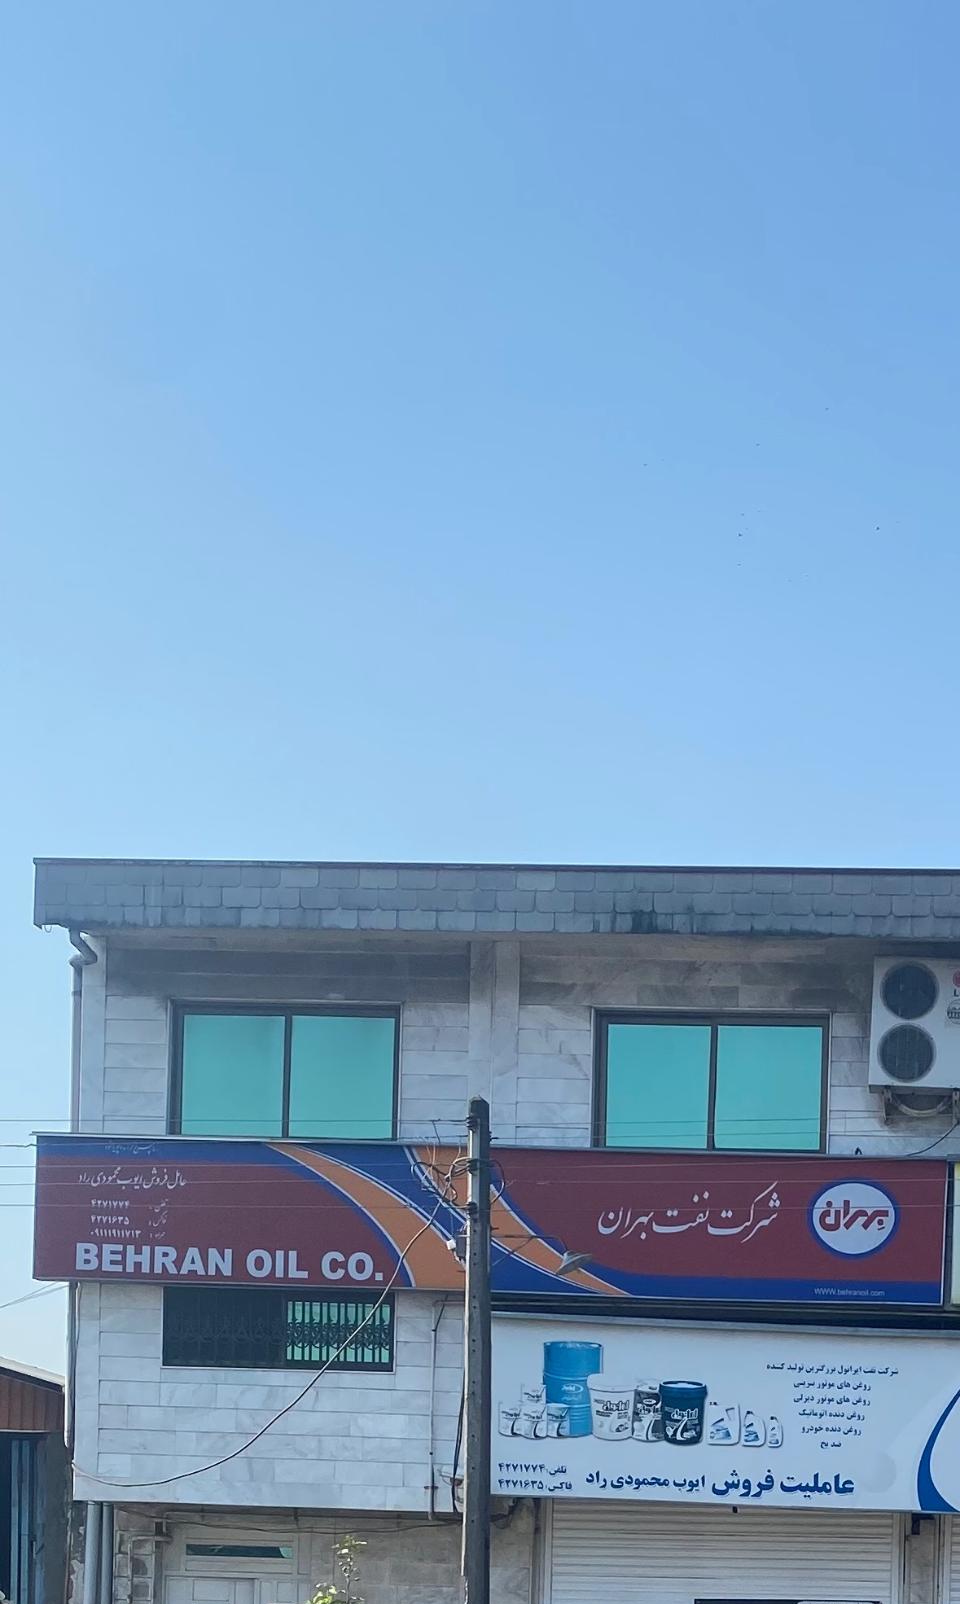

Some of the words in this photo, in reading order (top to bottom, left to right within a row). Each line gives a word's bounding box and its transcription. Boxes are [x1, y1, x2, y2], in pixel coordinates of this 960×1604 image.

[143, 1167, 168, 1189] فروش
[651, 1190, 710, 1234] نفت
[706, 1180, 781, 1244] شرکت
[819, 1199, 890, 1232] بهران
[597, 1206, 655, 1241] بهران
[75, 1242, 233, 1277] BEHRAN
[246, 1249, 309, 1280] OIL
[321, 1250, 384, 1282] CO.
[766, 1362, 785, 1371] کننده
[787, 1362, 804, 1373] تولید
[838, 1361, 862, 1376] ایرانول
[863, 1366, 876, 1375] نفت
[877, 1366, 899, 1377] شرکت
[817, 1381, 835, 1390] موتور
[836, 1381, 851, 1391] های
[852, 1382, 872, 1391] روغن
[817, 1397, 835, 1405] موتور
[836, 1396, 851, 1405] های
[852, 1397, 871, 1406] روغن
[846, 1412, 865, 1421] روغن
[801, 1425, 824, 1434] خودرو
[843, 1427, 862, 1436] روغن
[498, 1463, 545, 1473] ۴۲۷۱۷۷۴
[498, 1479, 544, 1490] ۴۲۷۱۶۳۵
[585, 1470, 607, 1489] راد
[610, 1473, 670, 1490] محمودی
[672, 1474, 706, 1493] ایوب
[711, 1469, 775, 1498] فروش
[779, 1471, 855, 1498] عاملیت
